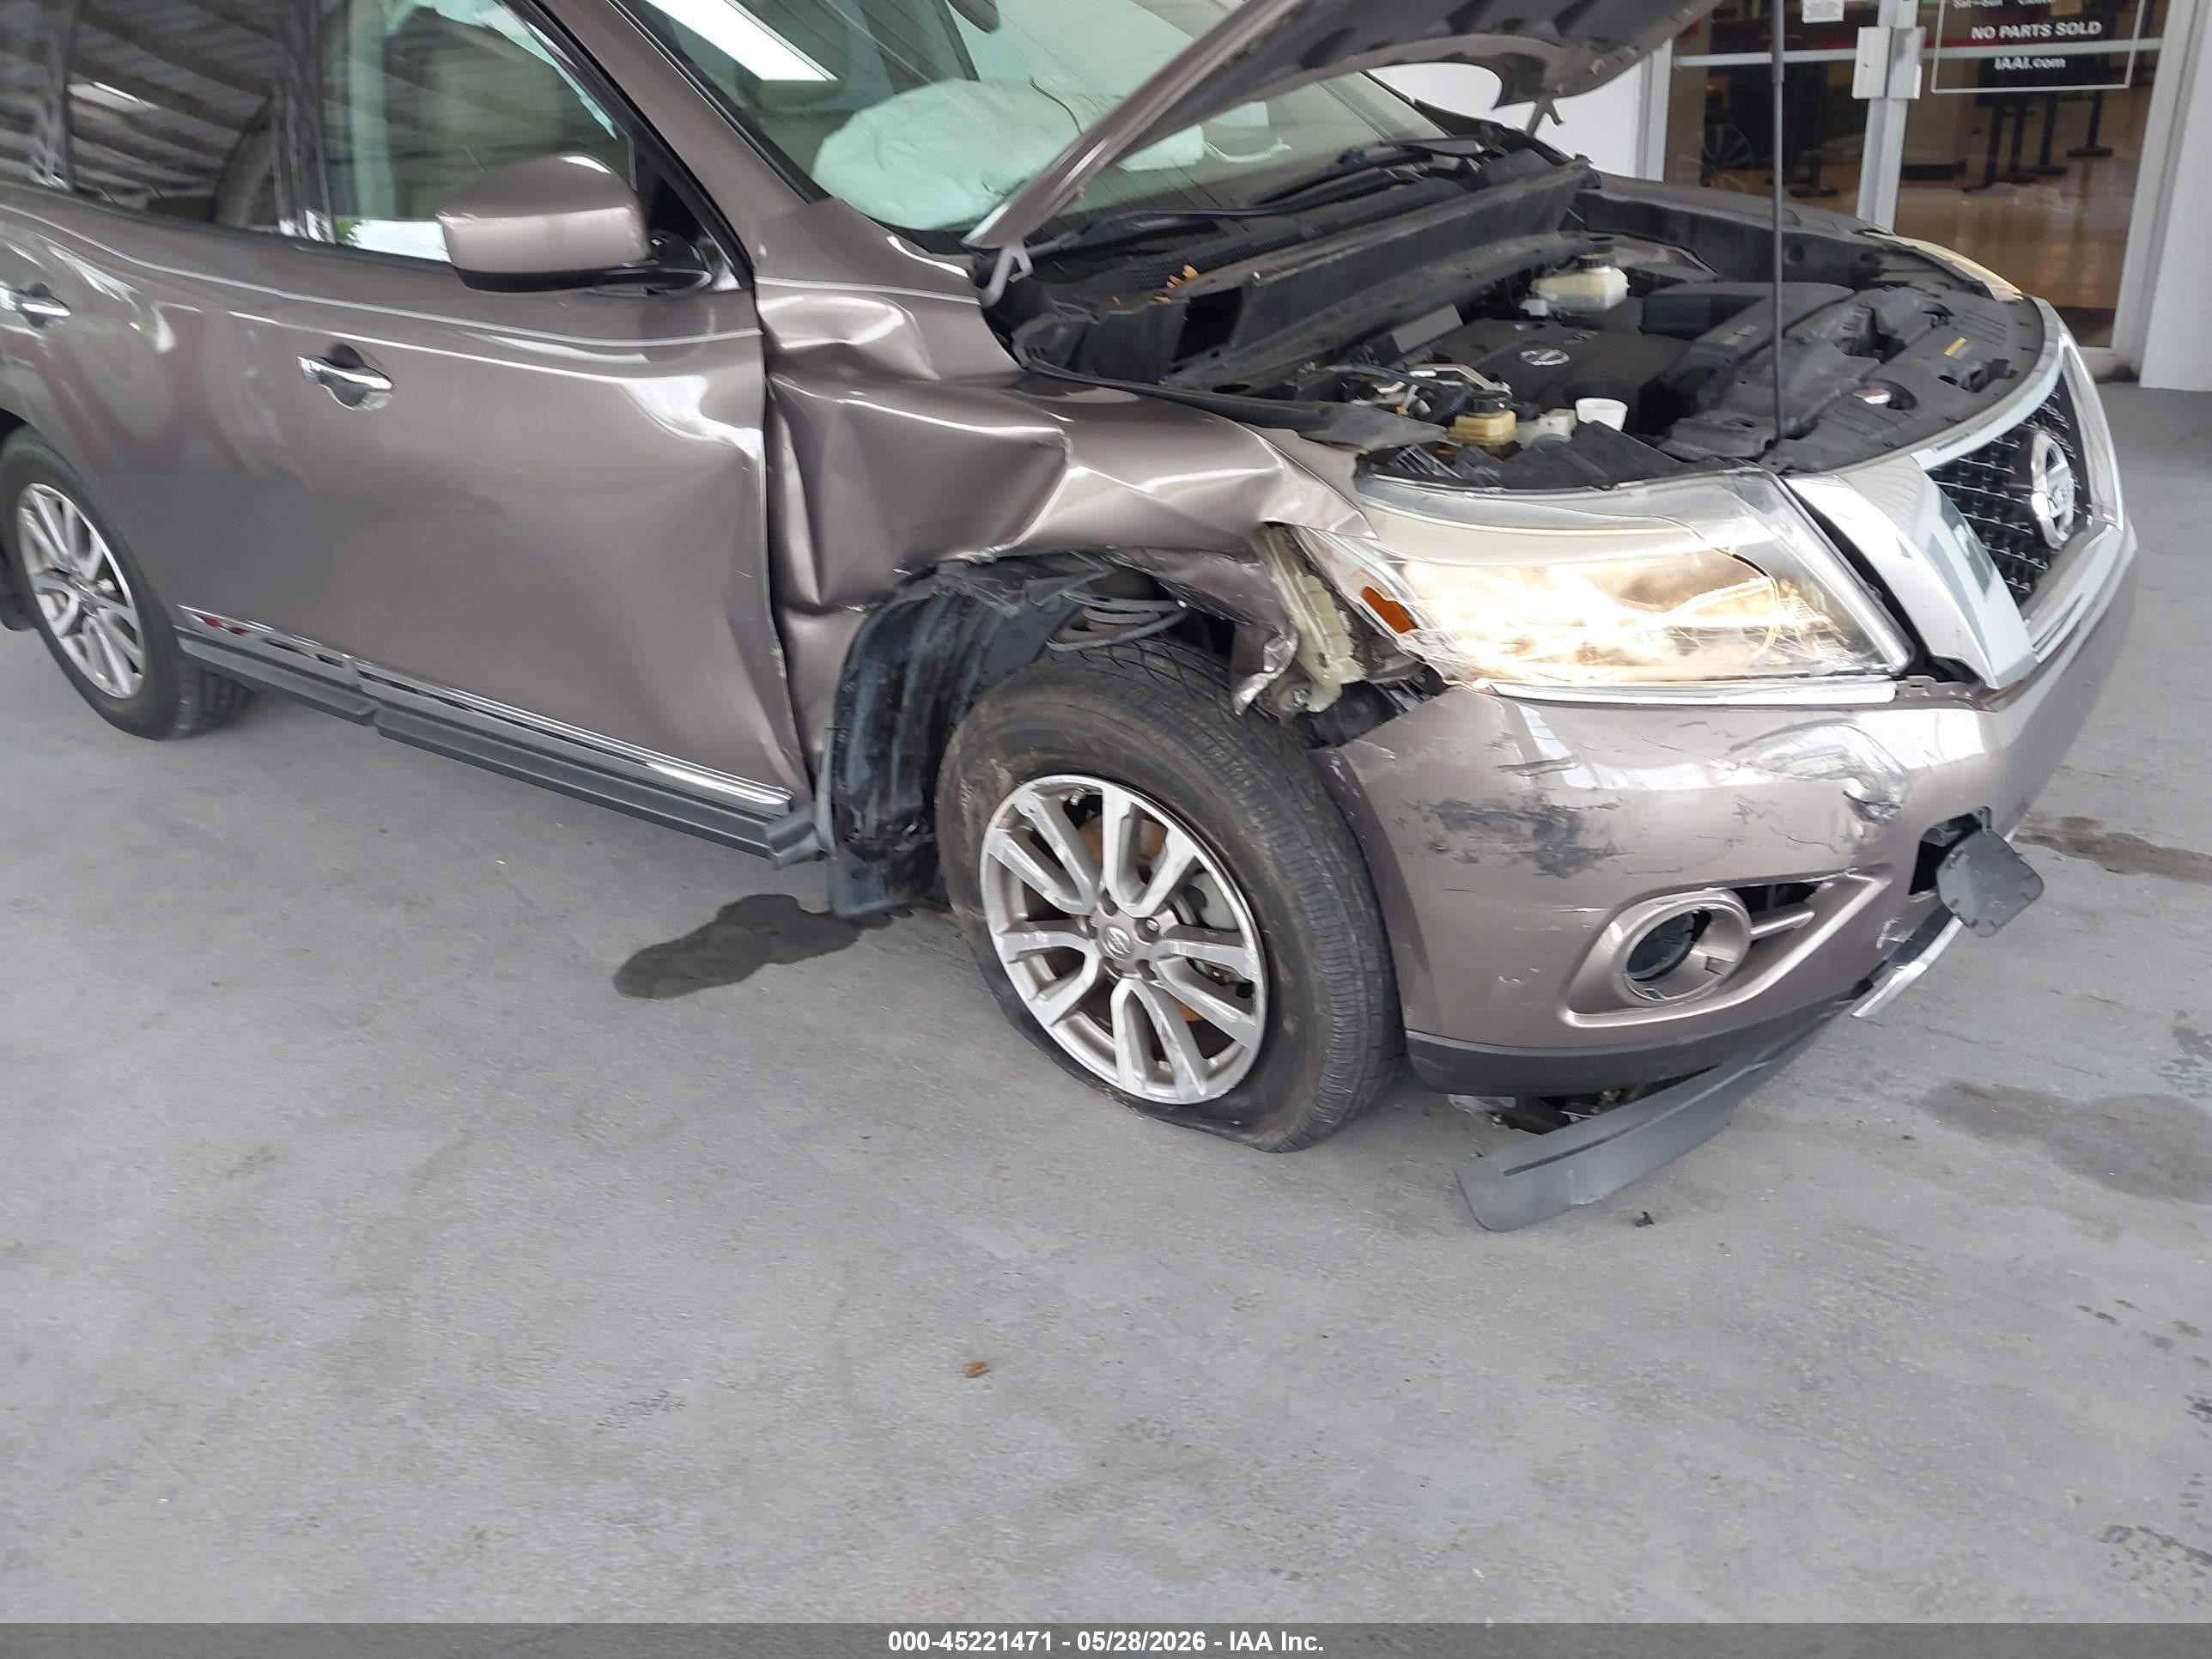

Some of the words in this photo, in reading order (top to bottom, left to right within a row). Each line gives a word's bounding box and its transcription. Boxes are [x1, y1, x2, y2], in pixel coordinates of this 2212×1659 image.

[1971, 26, 1996, 40] NO
[1998, 23, 2052, 39] PARTS
[2055, 21, 2102, 36] SOLD
[1994, 57, 2066, 70] IAAI.com
